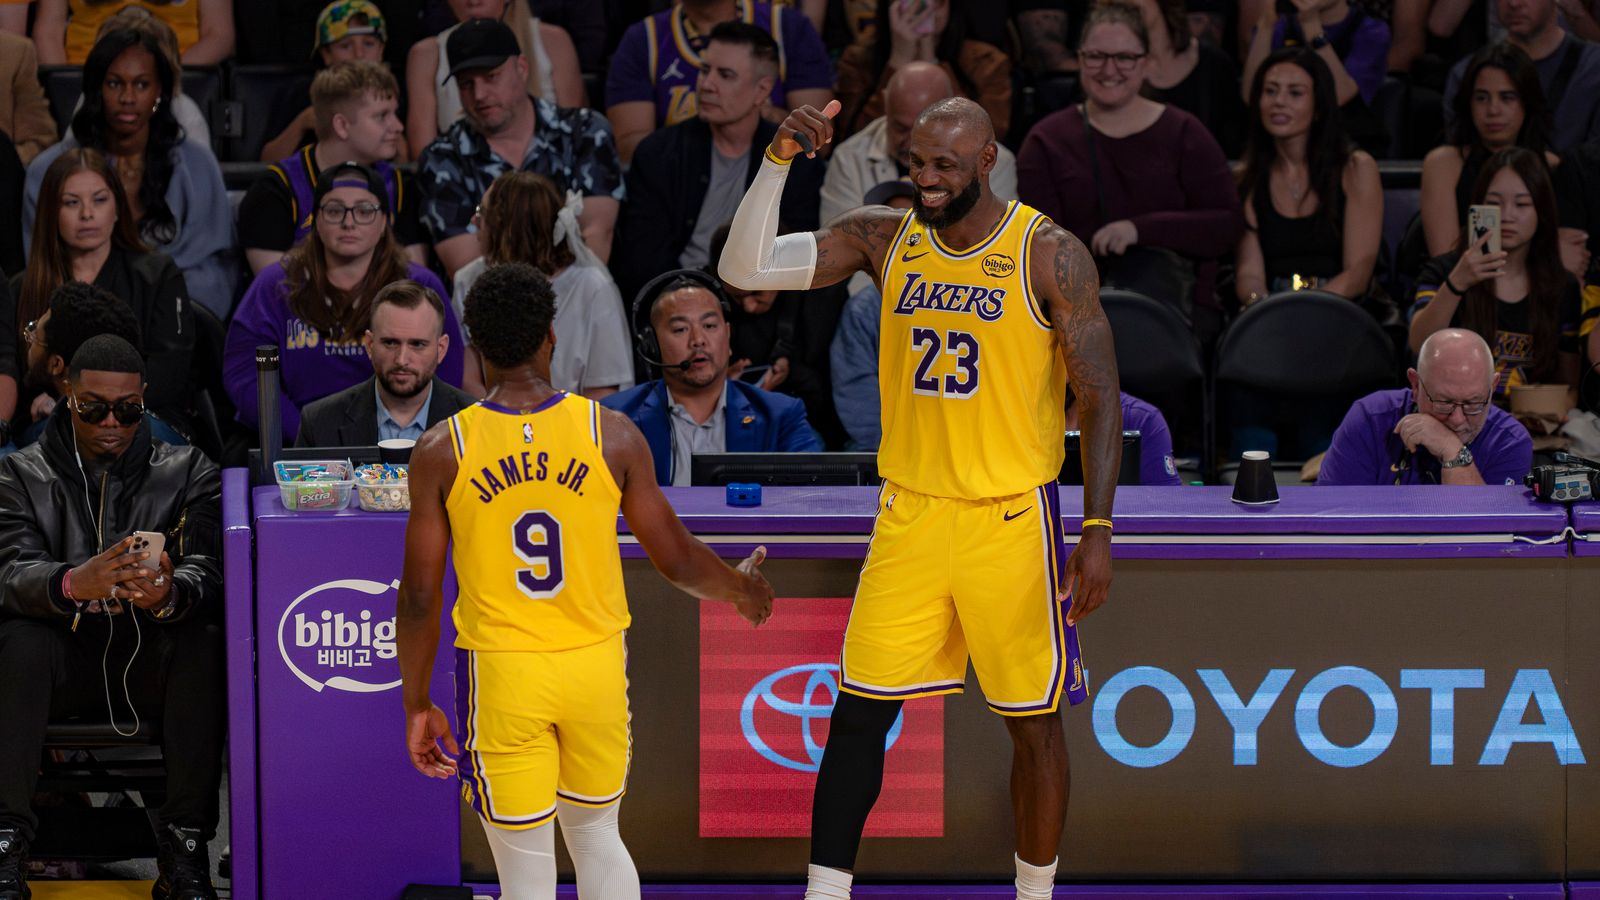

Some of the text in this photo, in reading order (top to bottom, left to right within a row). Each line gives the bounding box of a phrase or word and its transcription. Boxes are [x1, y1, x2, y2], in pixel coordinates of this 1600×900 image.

[985, 258, 1014, 272] bibigo
[893, 271, 1008, 323] LAKERS
[911, 326, 980, 400] 23
[300, 492, 331, 504] Extra
[469, 451, 590, 504] JAMES JR.
[511, 509, 567, 600] 9
[294, 609, 398, 659] bibig
[317, 649, 374, 668] 비비고
[1084, 665, 1588, 768] OYOTA
